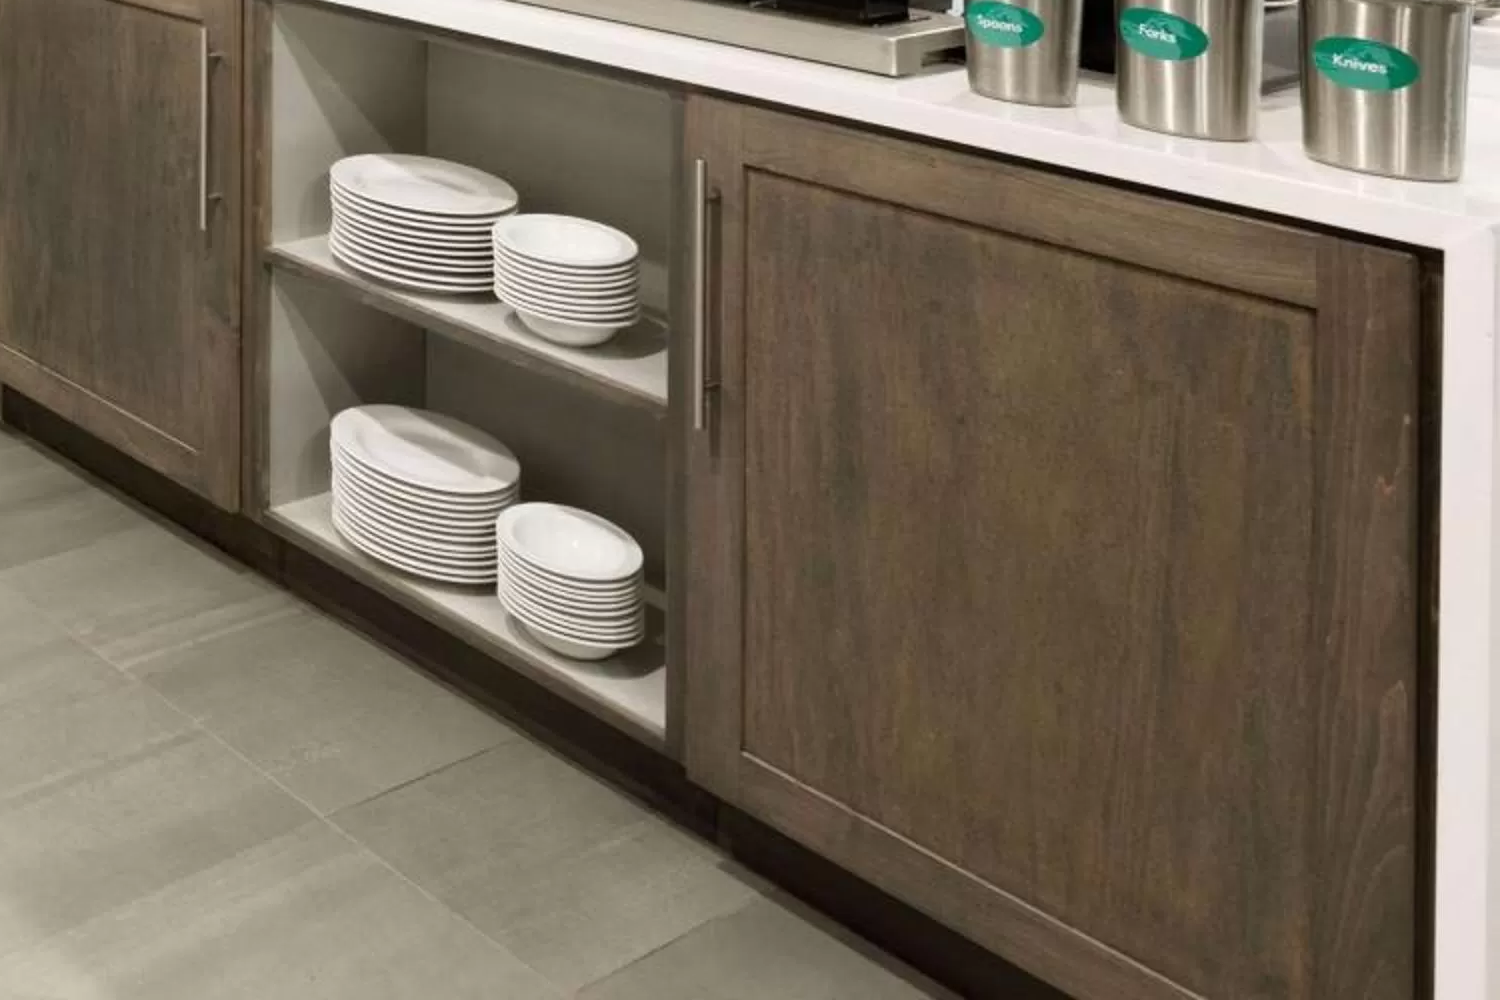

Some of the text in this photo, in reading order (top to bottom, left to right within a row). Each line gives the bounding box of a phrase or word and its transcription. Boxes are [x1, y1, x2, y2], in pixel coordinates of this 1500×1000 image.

[976, 13, 1023, 34] Spoons
[1139, 23, 1176, 43] Forks
[1332, 53, 1387, 74] Knives
